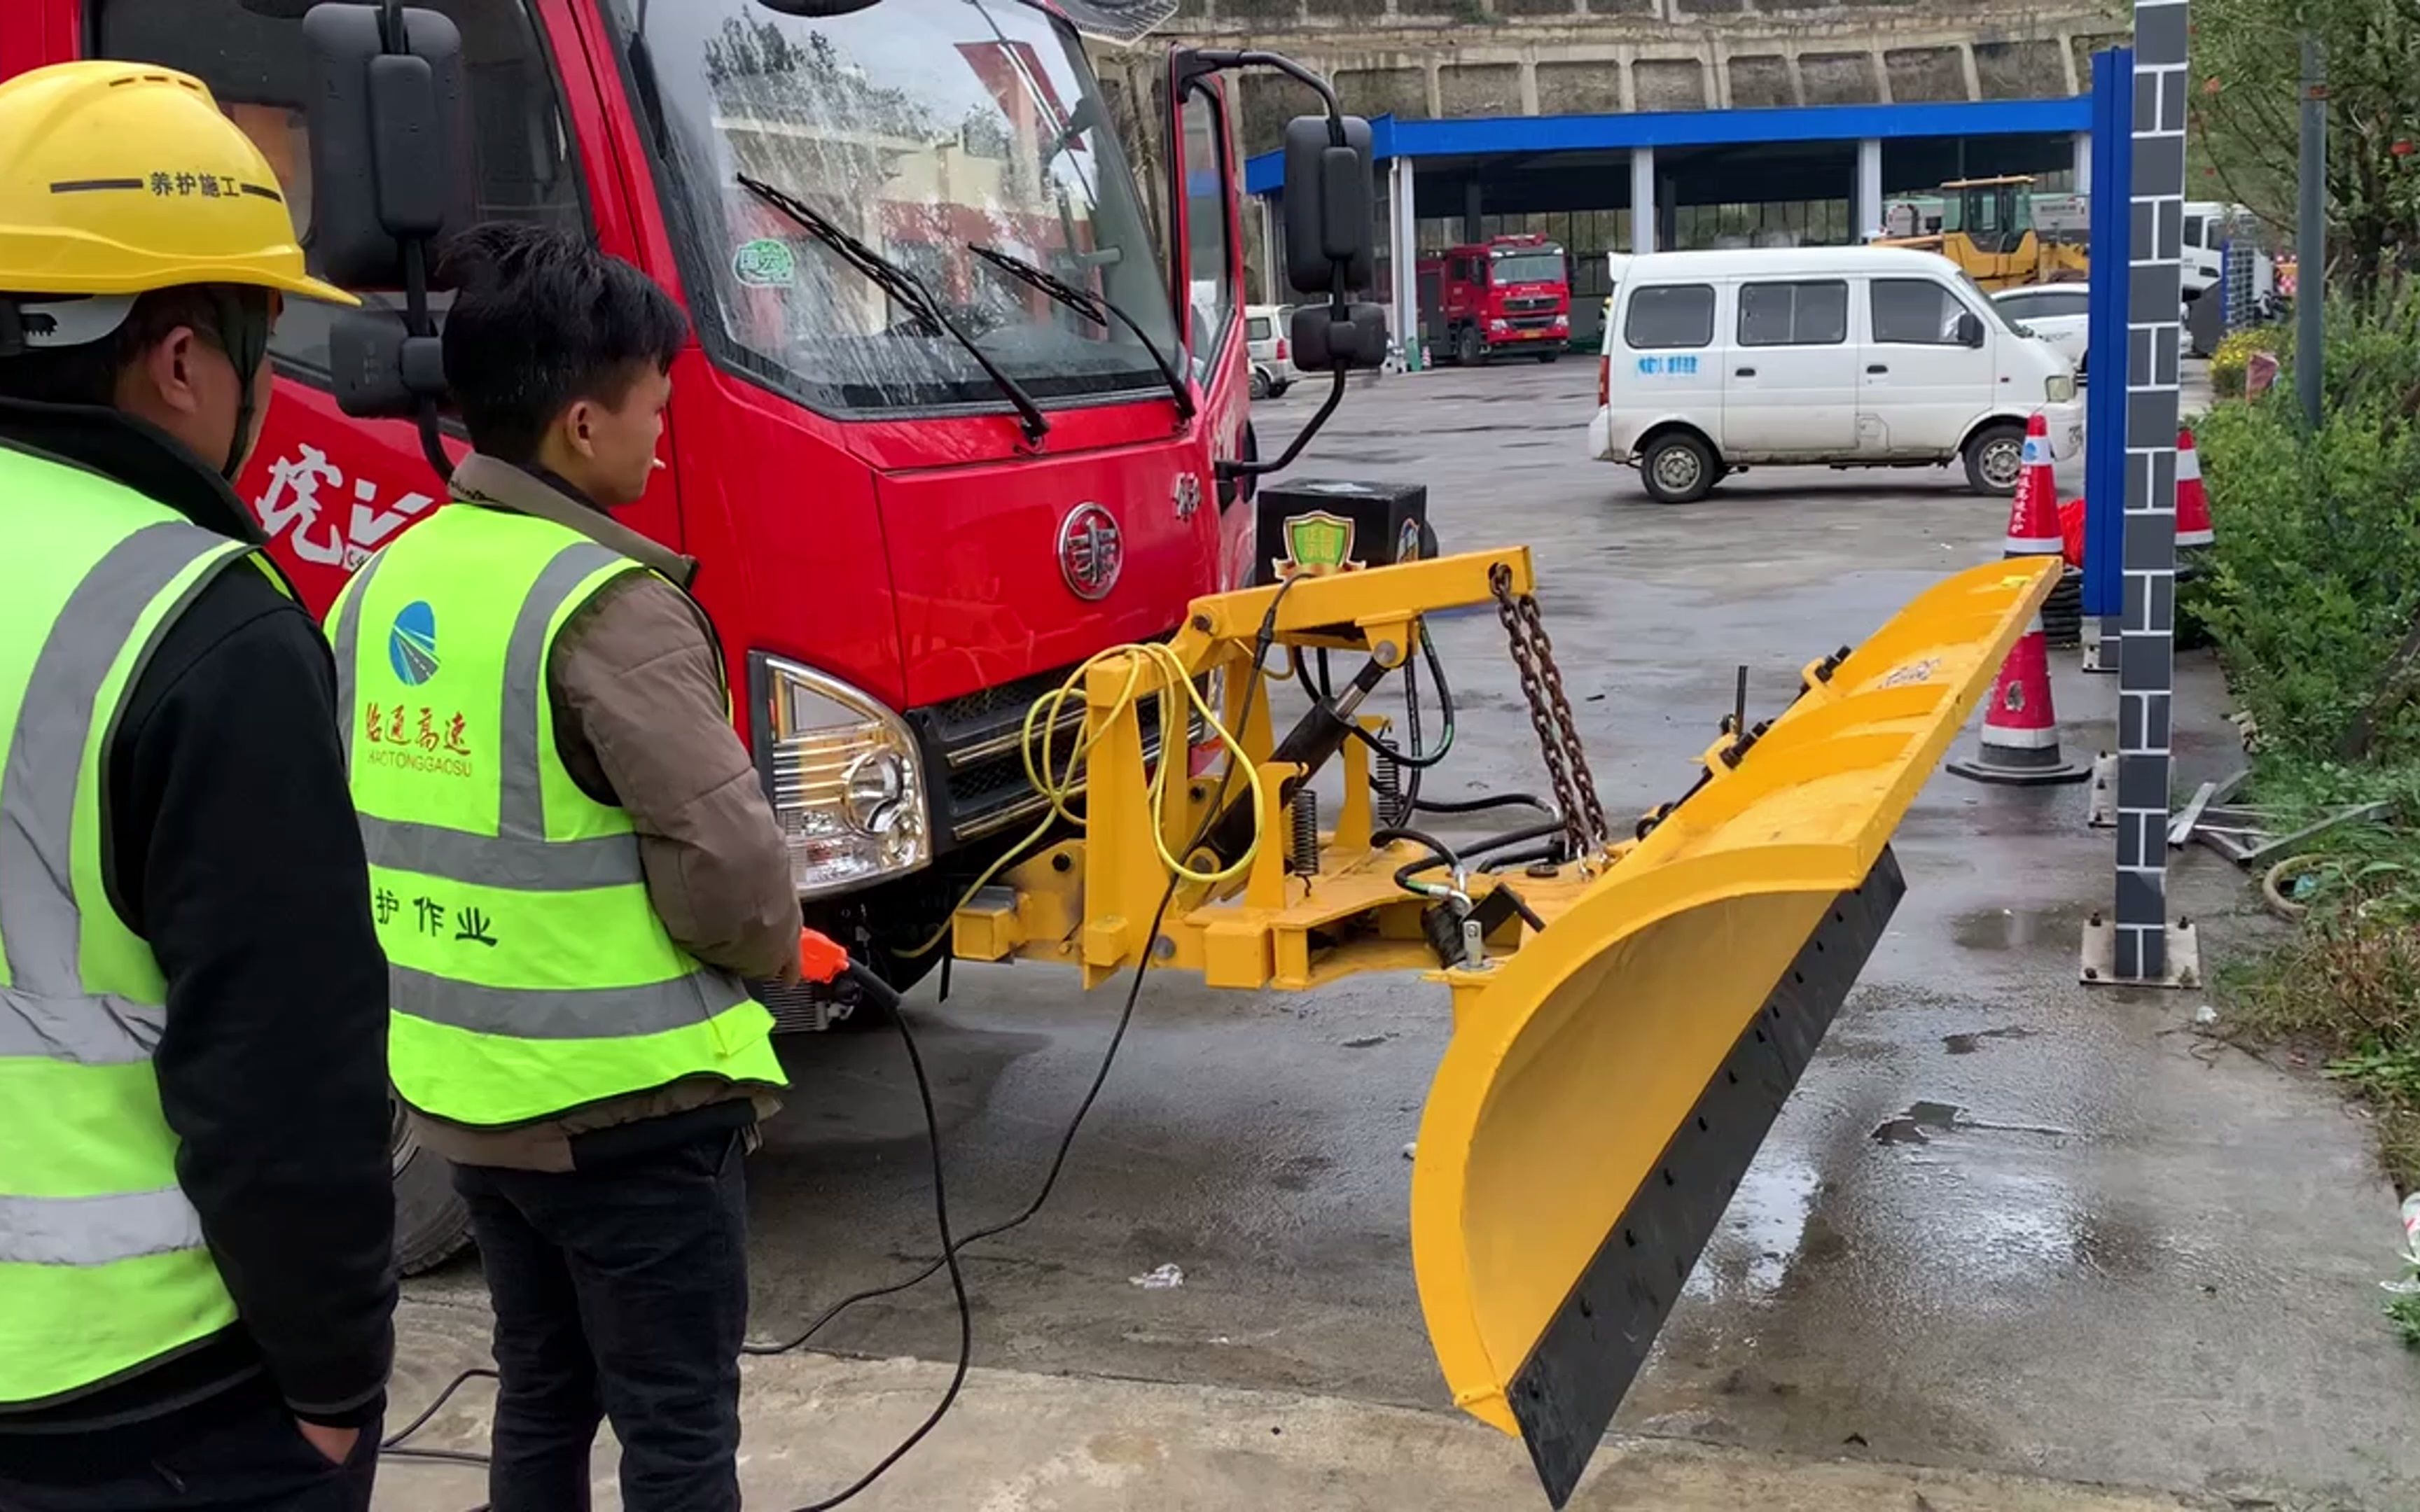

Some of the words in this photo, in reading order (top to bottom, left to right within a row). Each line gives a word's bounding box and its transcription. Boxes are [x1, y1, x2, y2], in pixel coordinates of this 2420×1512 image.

[151, 172, 240, 197] 养护施工
[375, 888, 498, 947] 护作业
